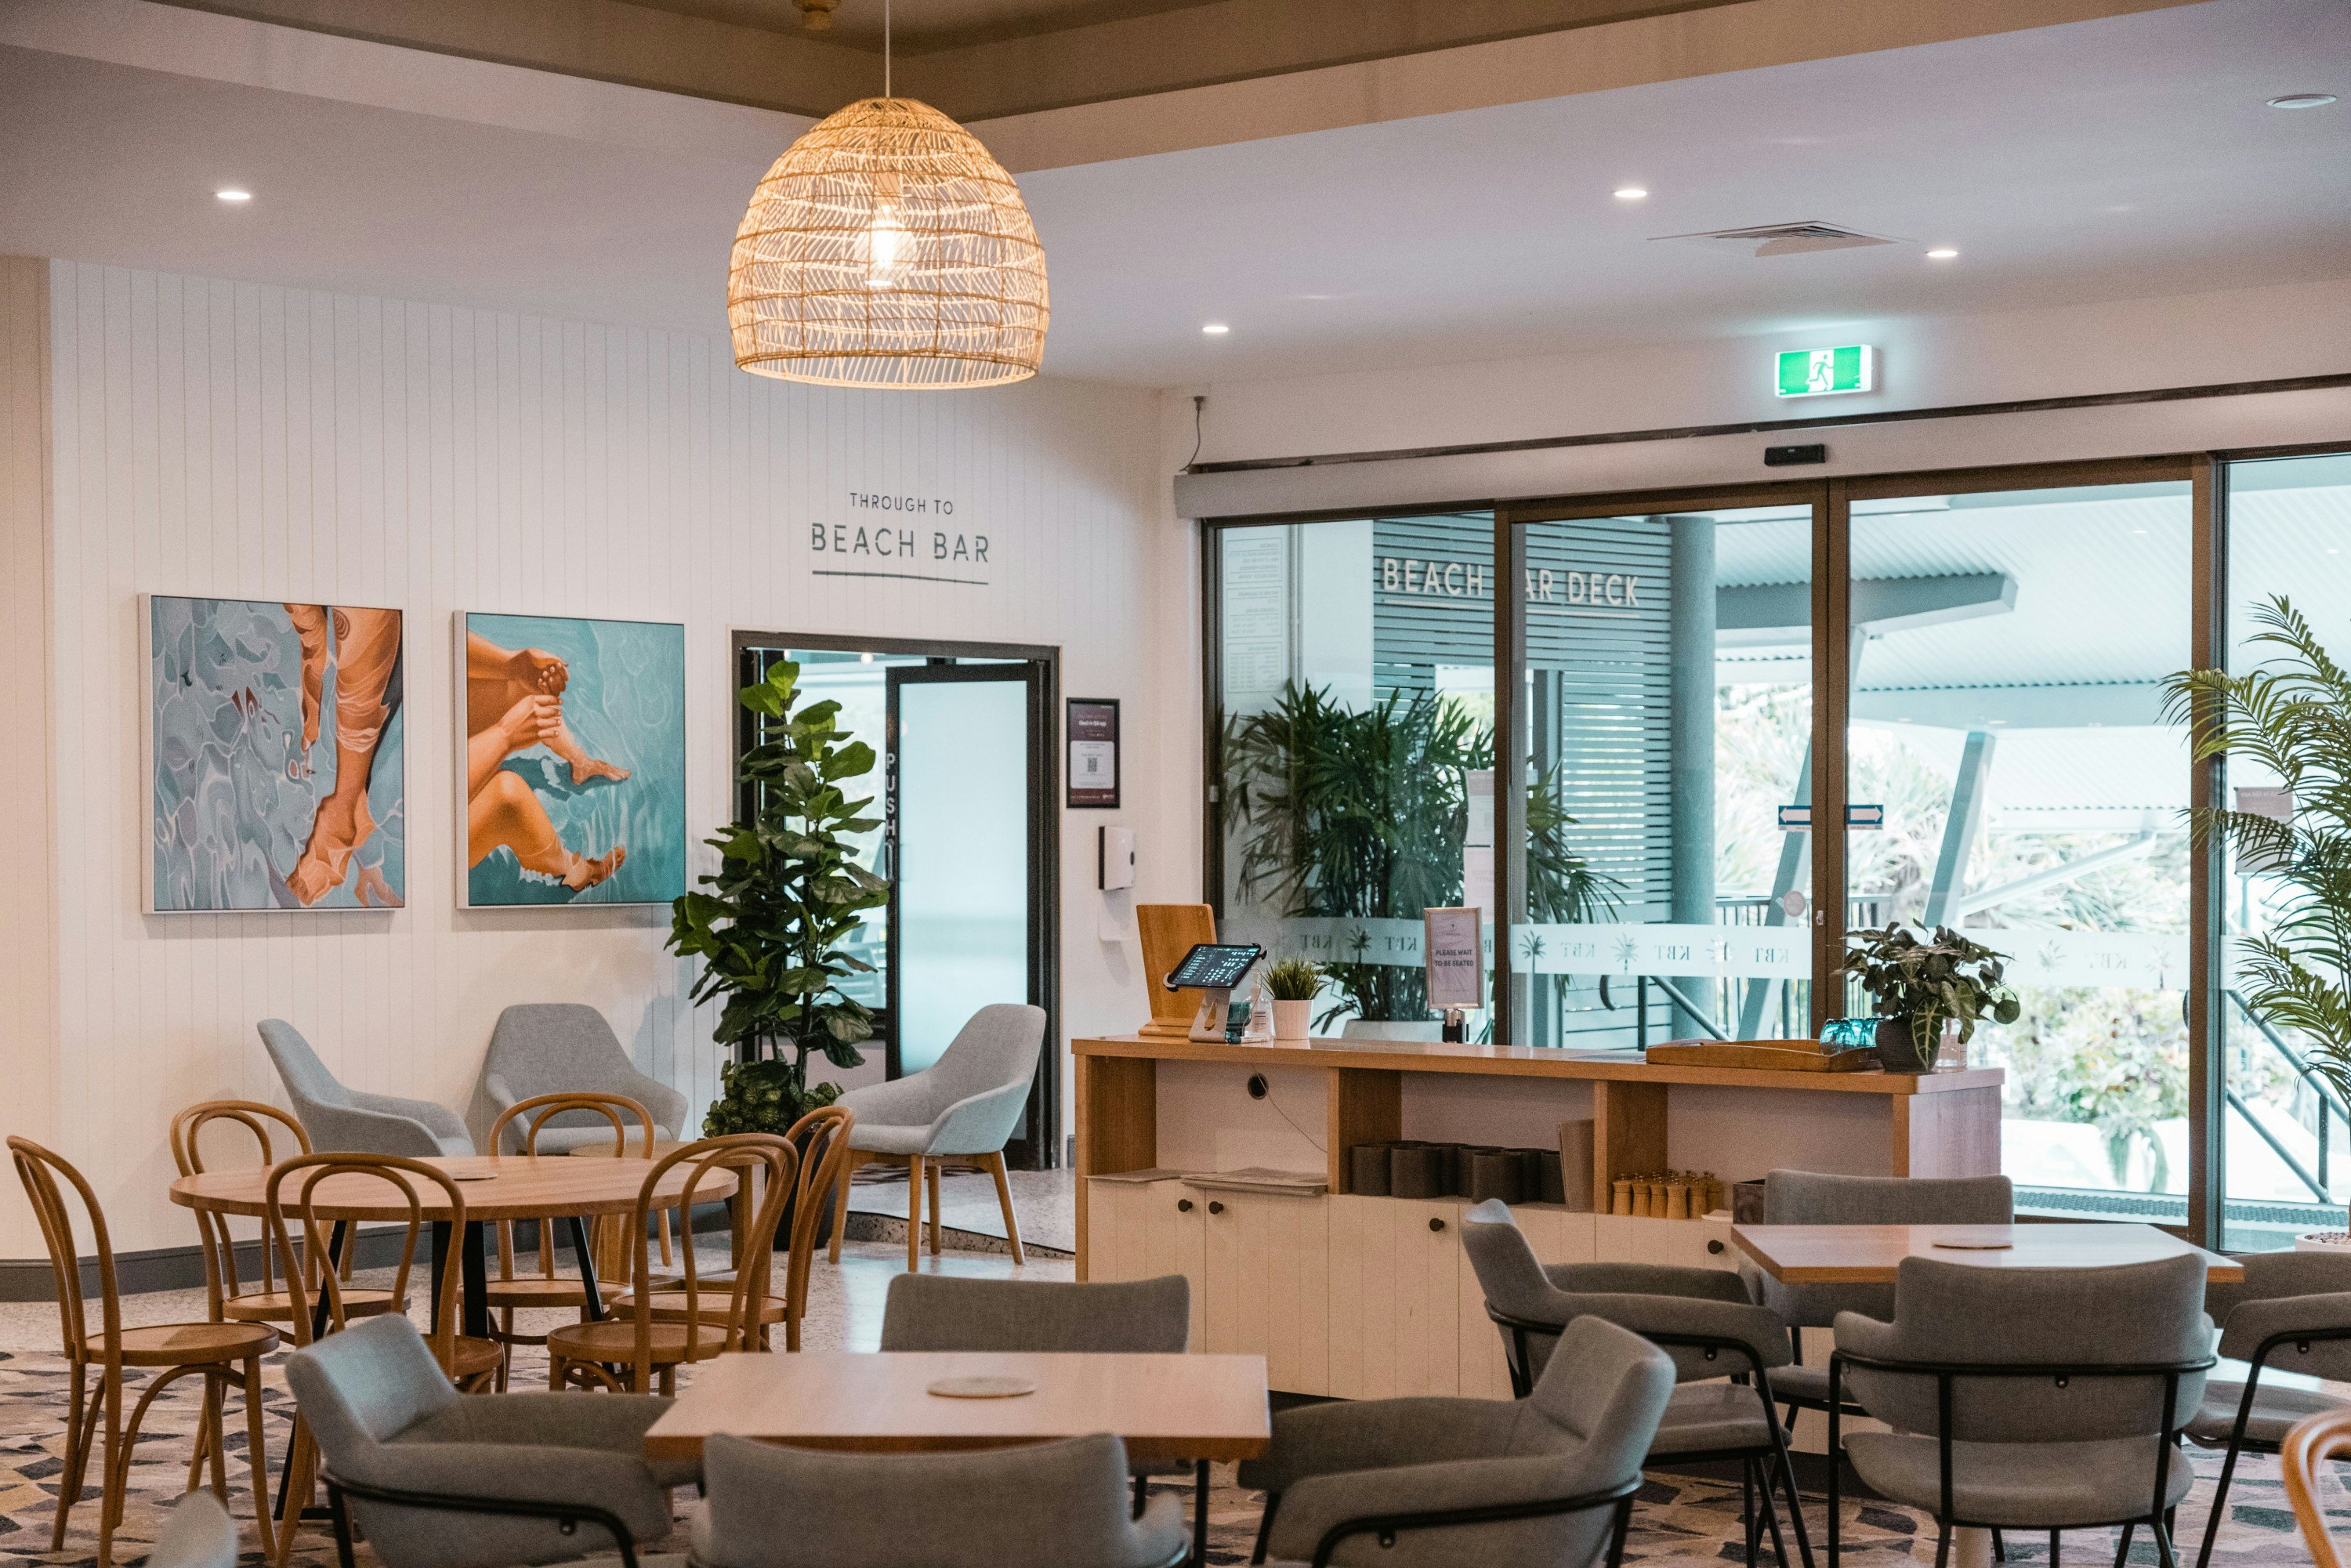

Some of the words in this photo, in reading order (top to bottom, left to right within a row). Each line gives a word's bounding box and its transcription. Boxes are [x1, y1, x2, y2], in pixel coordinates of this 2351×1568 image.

[849, 492, 926, 513] THROUGH
[933, 499, 954, 515] TO
[811, 522, 914, 558] BEACH
[933, 532, 989, 563] BAR
[1383, 558, 1483, 596] BEACH
[1525, 568, 1553, 601] AR
[1567, 571, 1639, 606] DECK
[886, 752, 896, 836] PUSH
